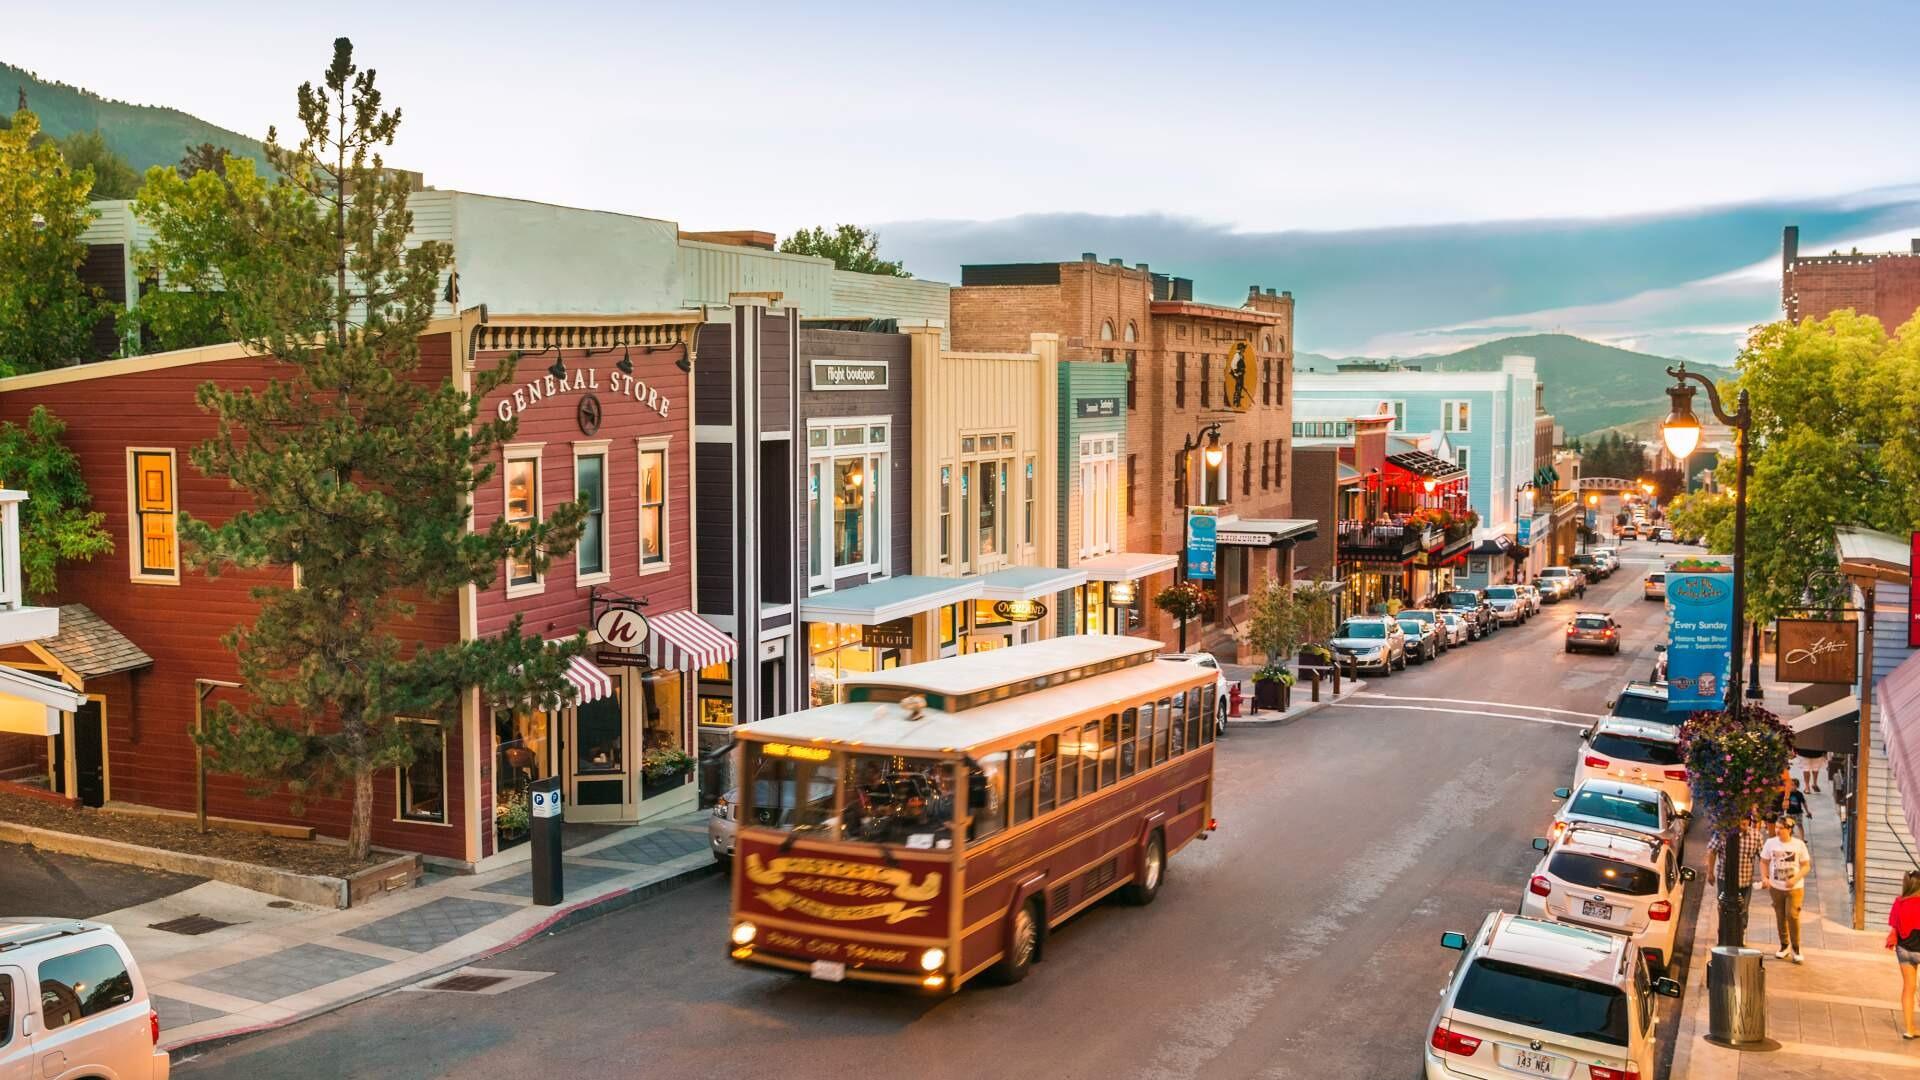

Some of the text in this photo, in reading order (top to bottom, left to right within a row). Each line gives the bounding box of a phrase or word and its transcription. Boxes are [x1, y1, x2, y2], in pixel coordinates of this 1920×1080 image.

[827, 366, 875, 384] flight boutique
[498, 368, 670, 422] GENERAL STORE
[998, 602, 1044, 615] OVERLAND
[607, 611, 638, 643] h
[1674, 621, 1728, 631] Every Sunday
[864, 634, 912, 645] FLIGHT
[1516, 1055, 1532, 1068] 143
[1535, 1060, 1550, 1073] NEA
